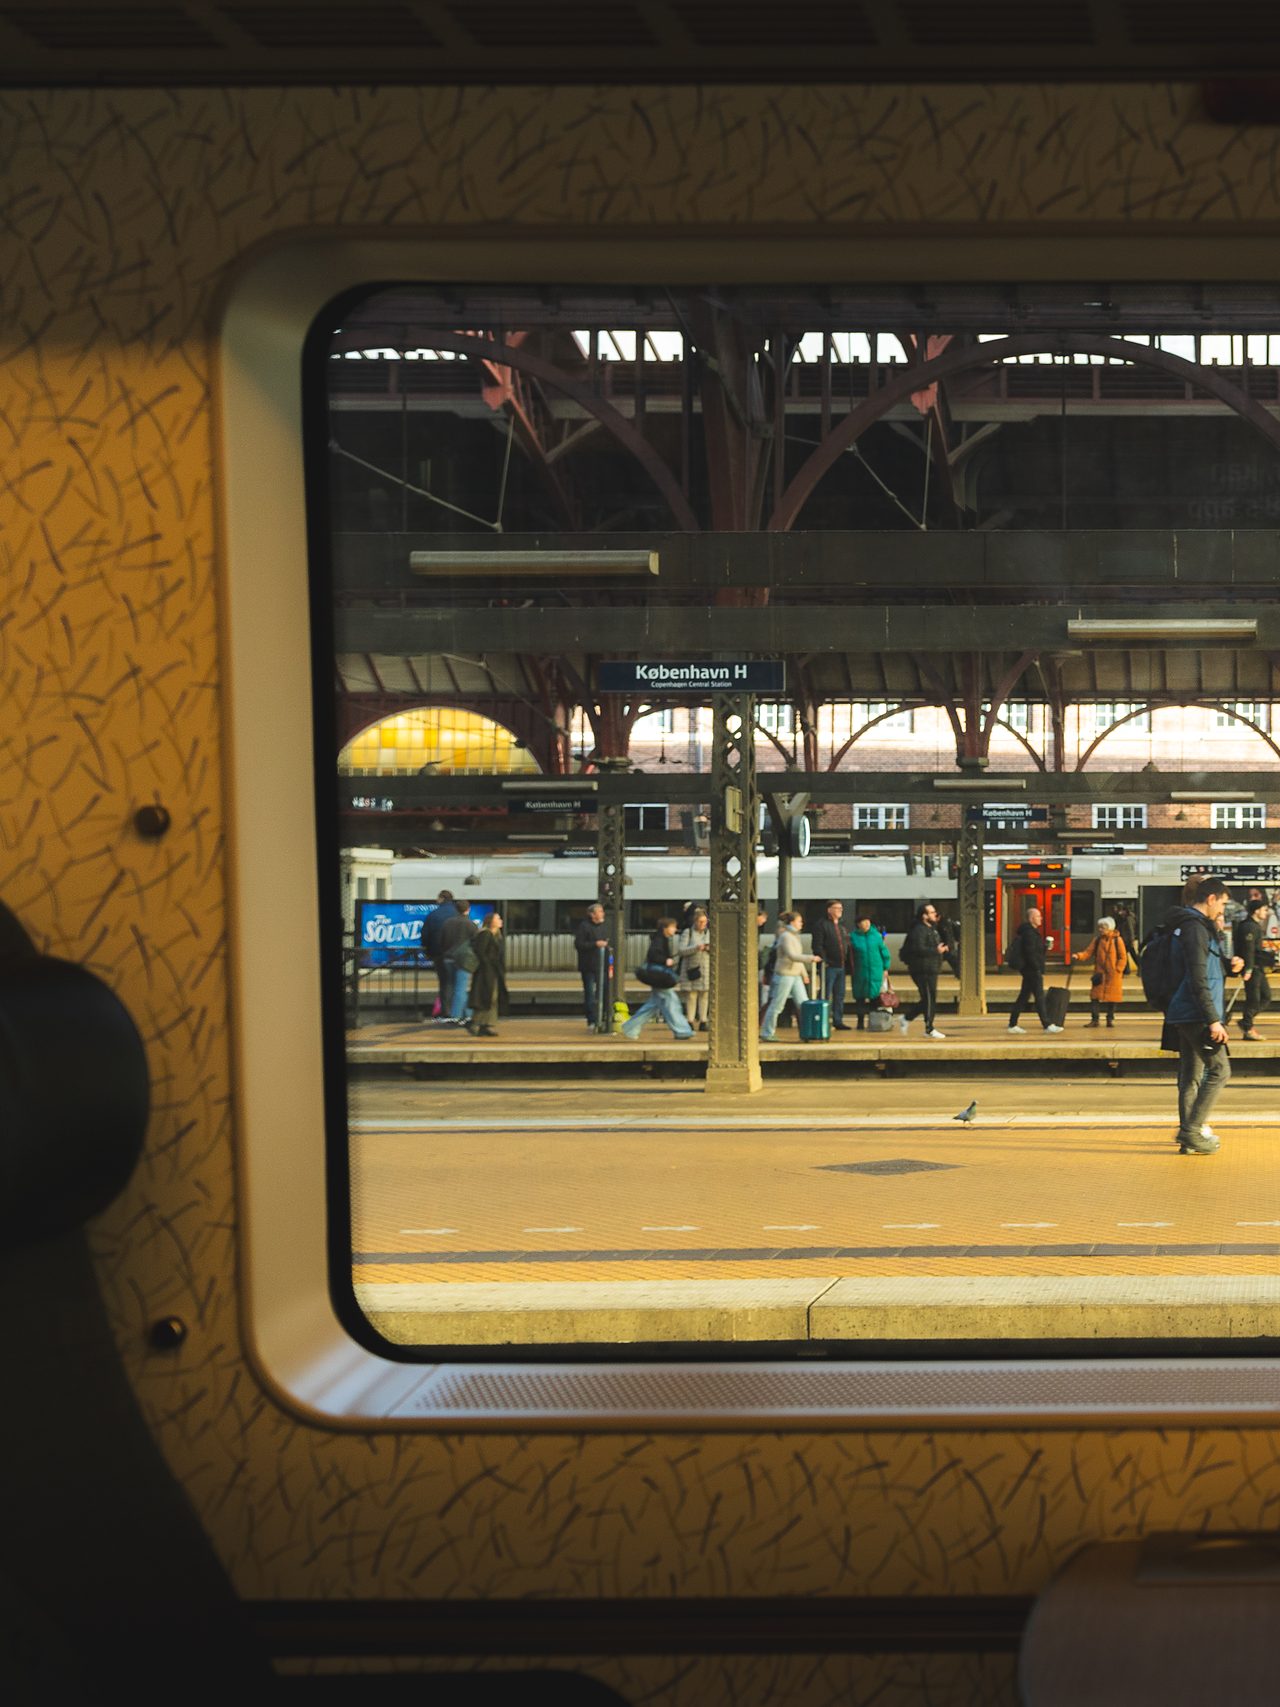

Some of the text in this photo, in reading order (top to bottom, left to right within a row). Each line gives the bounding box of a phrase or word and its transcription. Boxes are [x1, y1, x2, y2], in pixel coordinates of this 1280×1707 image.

[636, 664, 748, 680] København H
[982, 808, 1032, 817] København H
